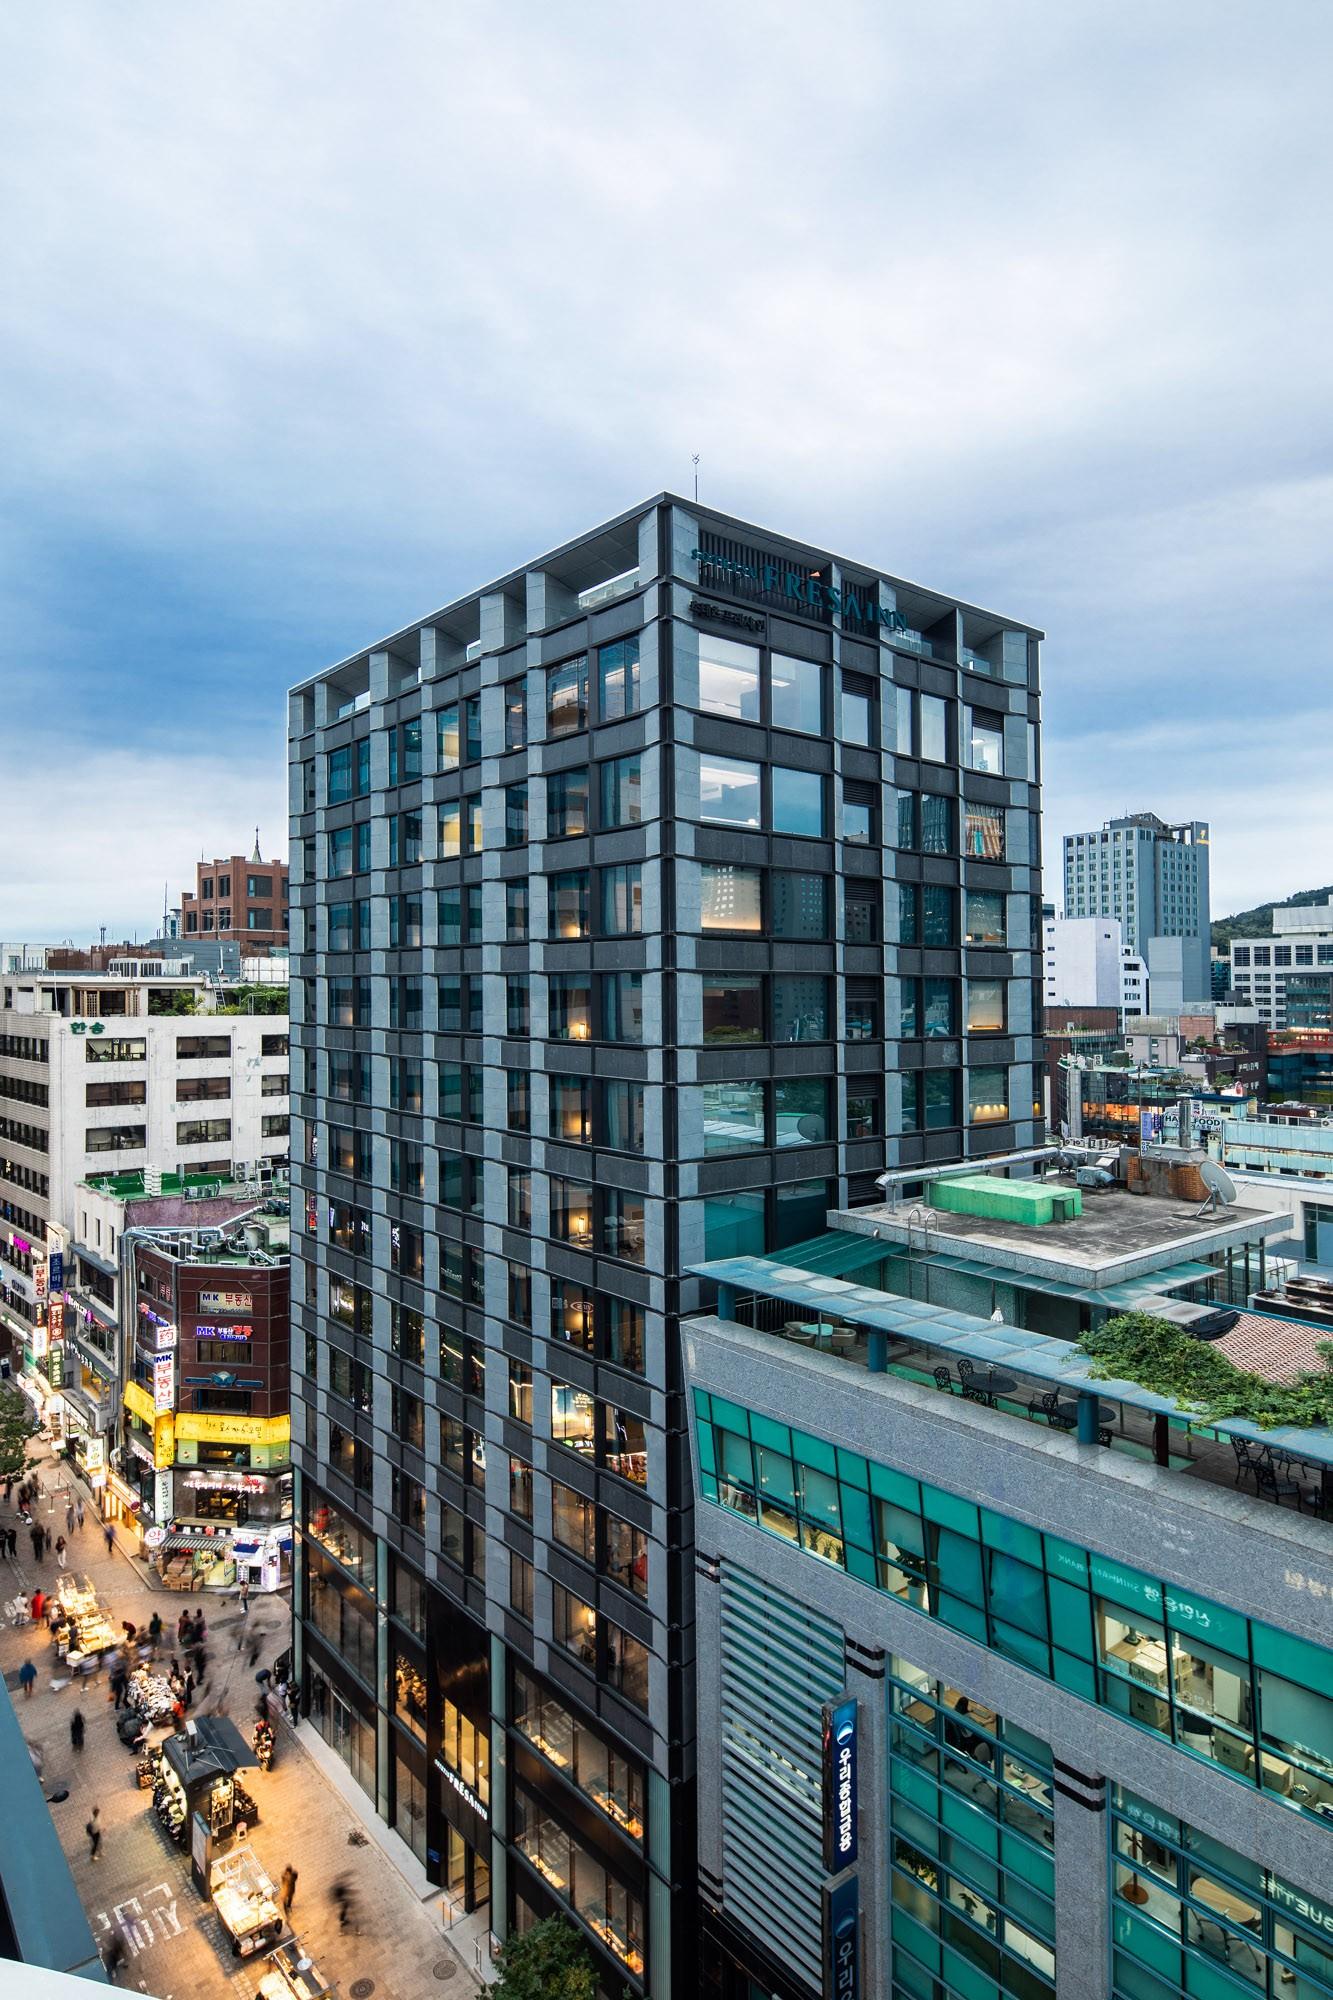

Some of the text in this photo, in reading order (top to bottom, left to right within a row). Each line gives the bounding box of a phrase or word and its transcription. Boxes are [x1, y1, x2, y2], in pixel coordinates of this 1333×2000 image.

[865, 601, 907, 631] INN
[225, 1293, 252, 1307] 부동산
[196, 1325, 216, 1336] MK
[154, 1353, 173, 1363] MK
[157, 1363, 173, 1403] 부동산
[838, 1747, 853, 1852] 우리종합금융
